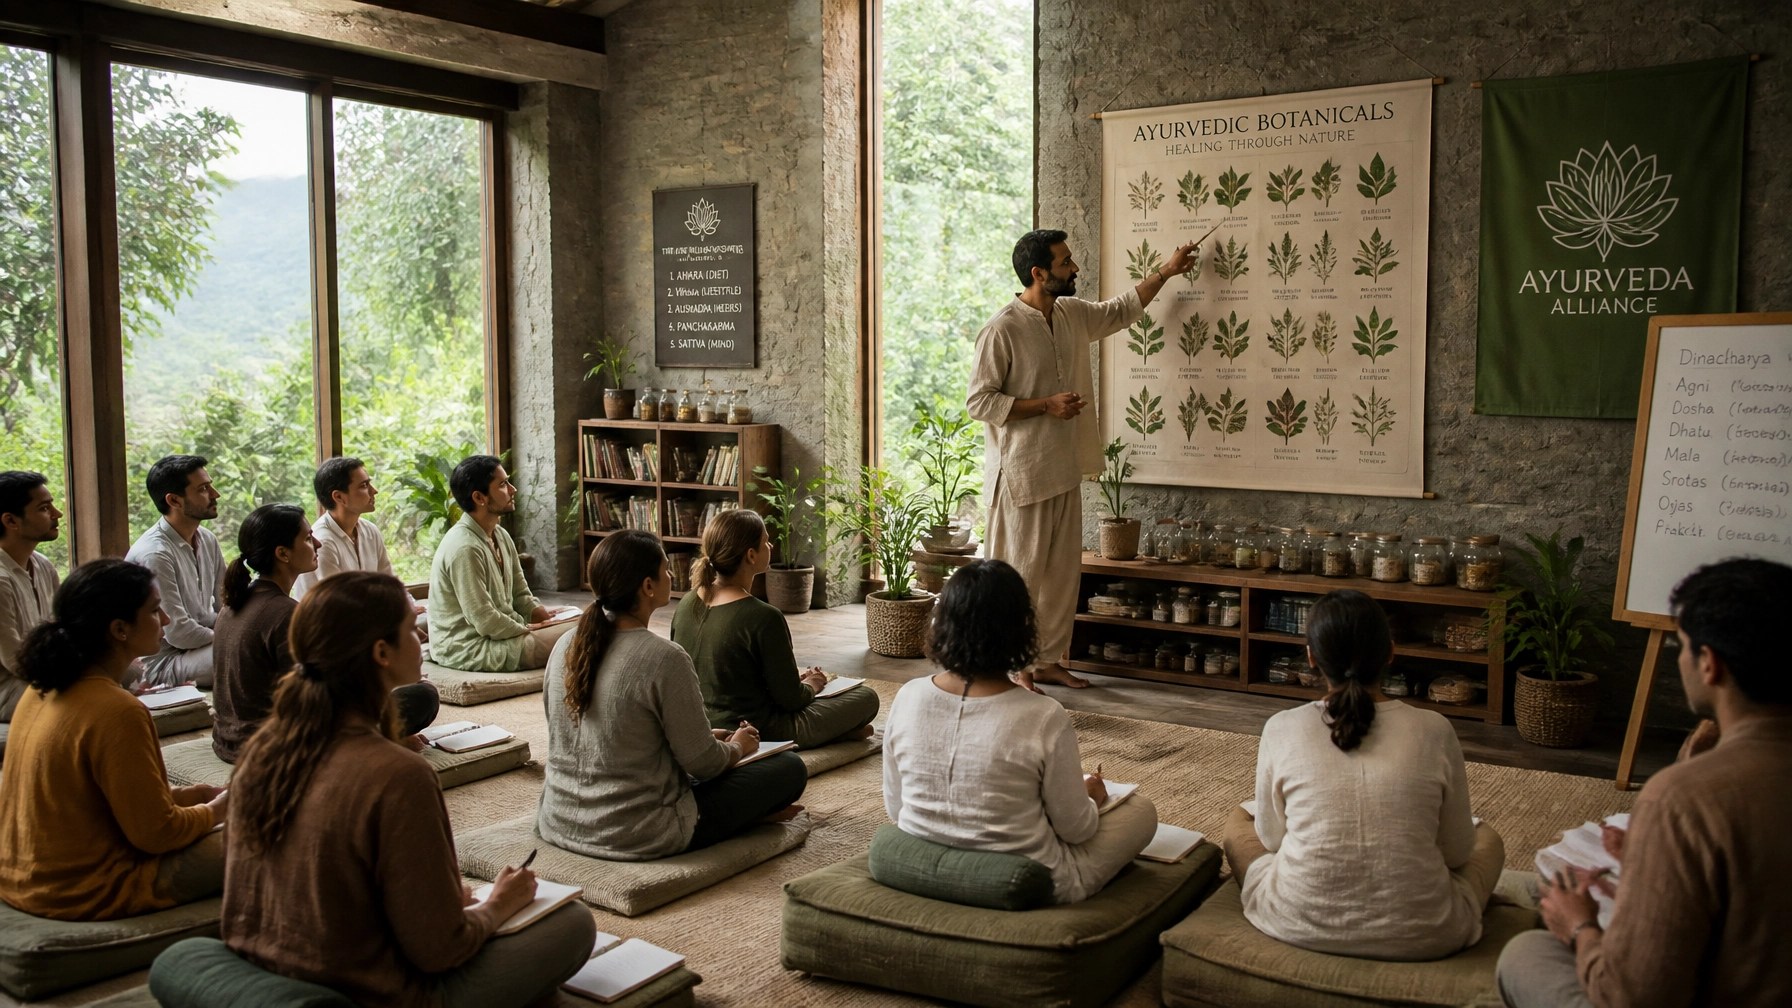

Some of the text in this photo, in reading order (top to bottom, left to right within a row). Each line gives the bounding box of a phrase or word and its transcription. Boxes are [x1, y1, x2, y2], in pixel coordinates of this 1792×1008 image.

[1133, 102, 1395, 142] AYURVEDIC BOTANICALS
[1165, 129, 1356, 156] HEALING THROUGH NATURE
[706, 269, 729, 280] (DIET)
[1518, 266, 1694, 294] AYURVEDA
[1551, 297, 1658, 315] ALLIANCE
[678, 339, 706, 349] SATTVA
[1675, 377, 1710, 396] Agni
[1672, 400, 1715, 415] Dosha
[1669, 421, 1711, 437] Dhatu
[1664, 447, 1700, 462] Mala
[1662, 470, 1708, 488] Srotas
